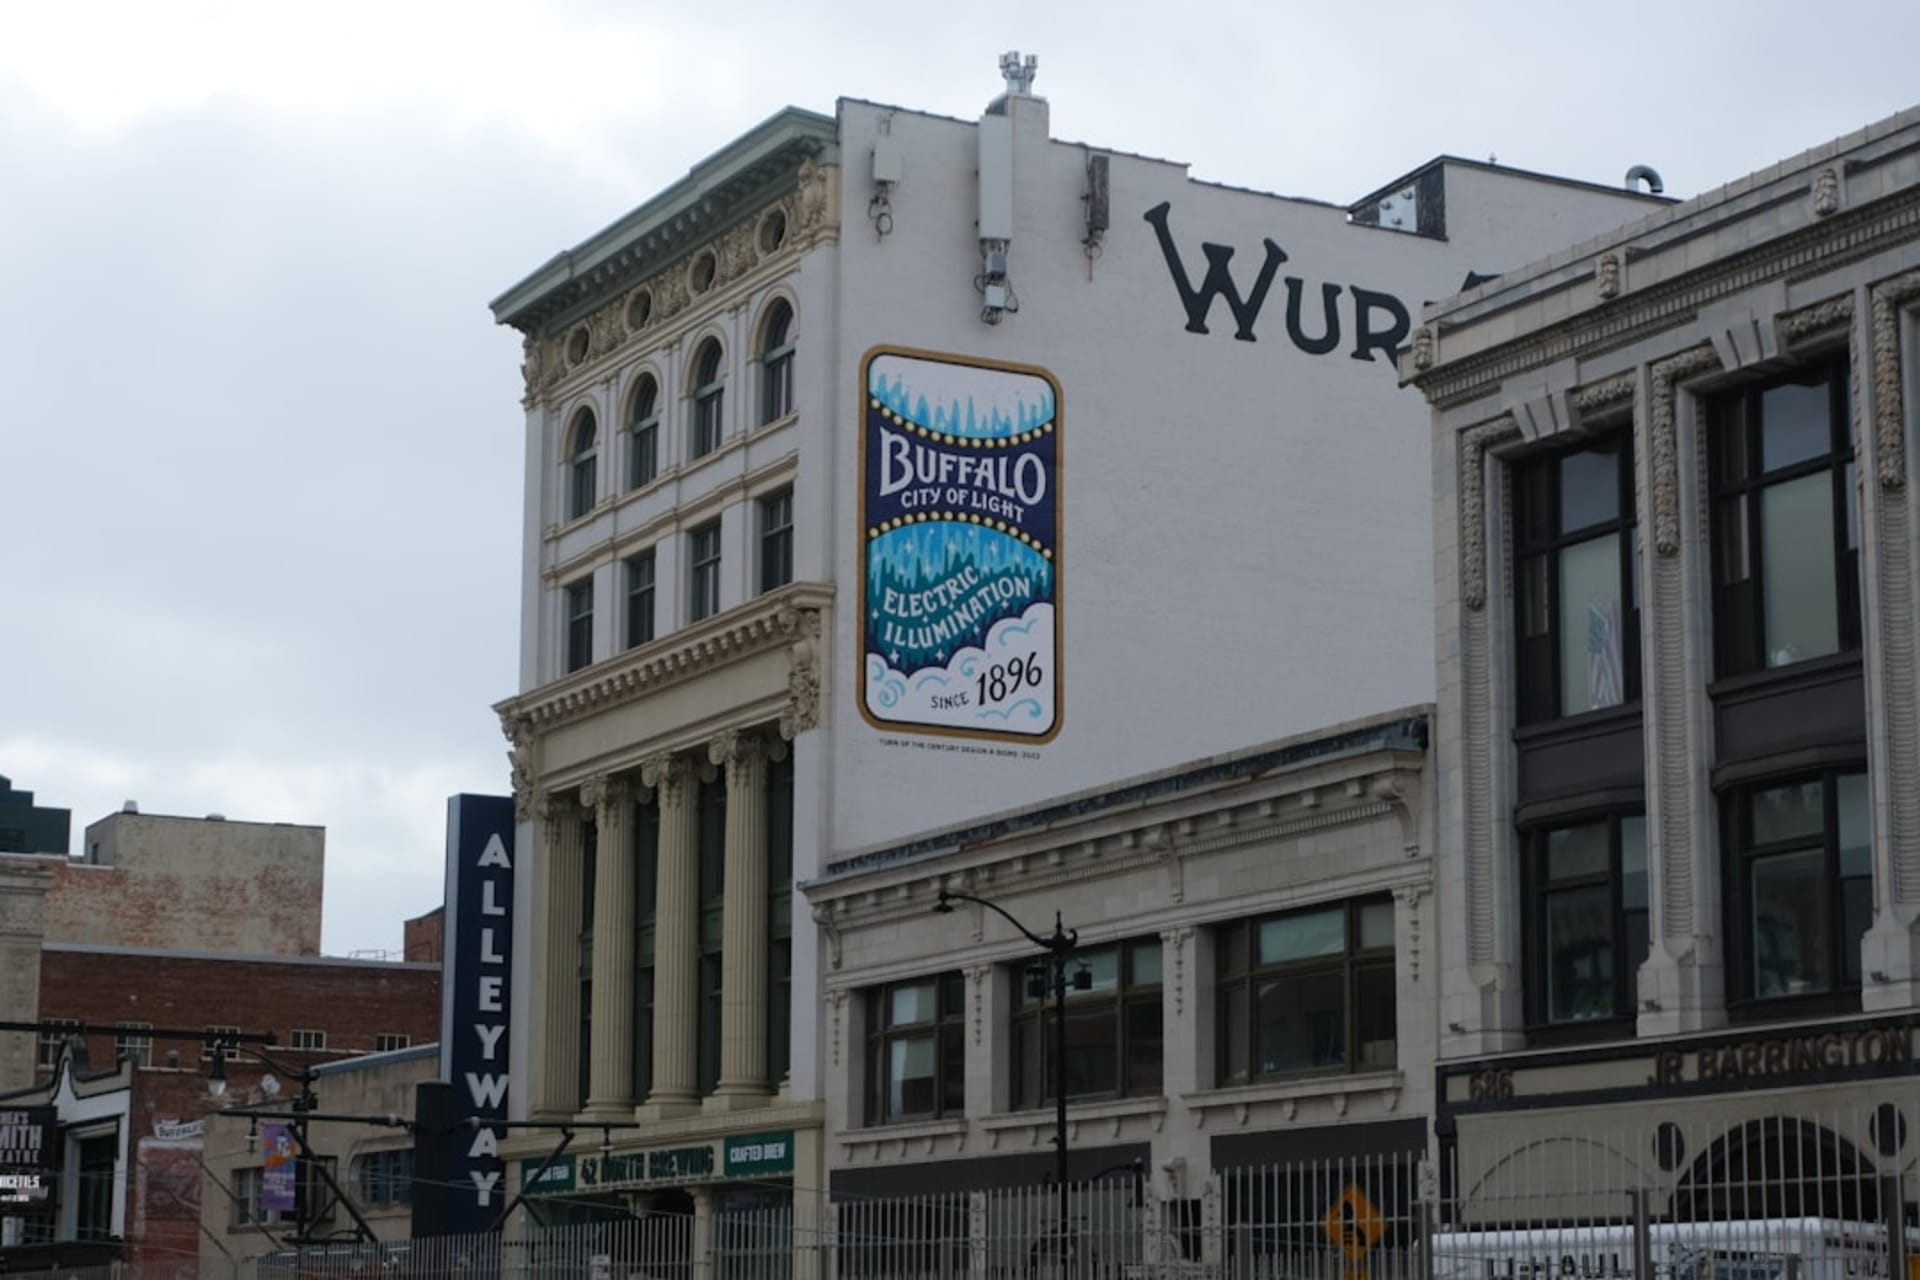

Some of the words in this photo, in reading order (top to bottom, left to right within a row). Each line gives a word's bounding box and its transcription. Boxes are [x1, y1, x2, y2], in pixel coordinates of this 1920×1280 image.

[1143, 200, 1411, 368] WUR
[879, 425, 1046, 506] BUFFALO
[901, 487, 941, 508] CITY
[946, 487, 970, 507] OF
[970, 491, 1024, 523] LIGHT
[883, 565, 979, 618] ELECTRIC
[884, 576, 1031, 649] ILLUMINATION
[930, 691, 970, 710] SINCE
[976, 651, 1043, 707] 1896
[465, 832, 513, 1207] ALLEYWAY
[1697, 1027, 1913, 1081] BARRINGTON
[1469, 1070, 1514, 1100] 686
[581, 1158, 598, 1185] 42
[601, 1153, 645, 1183] NORTH
[650, 1145, 714, 1179] BREWING
[730, 1145, 763, 1164] CRAFTED
[764, 1142, 786, 1160] BREW
